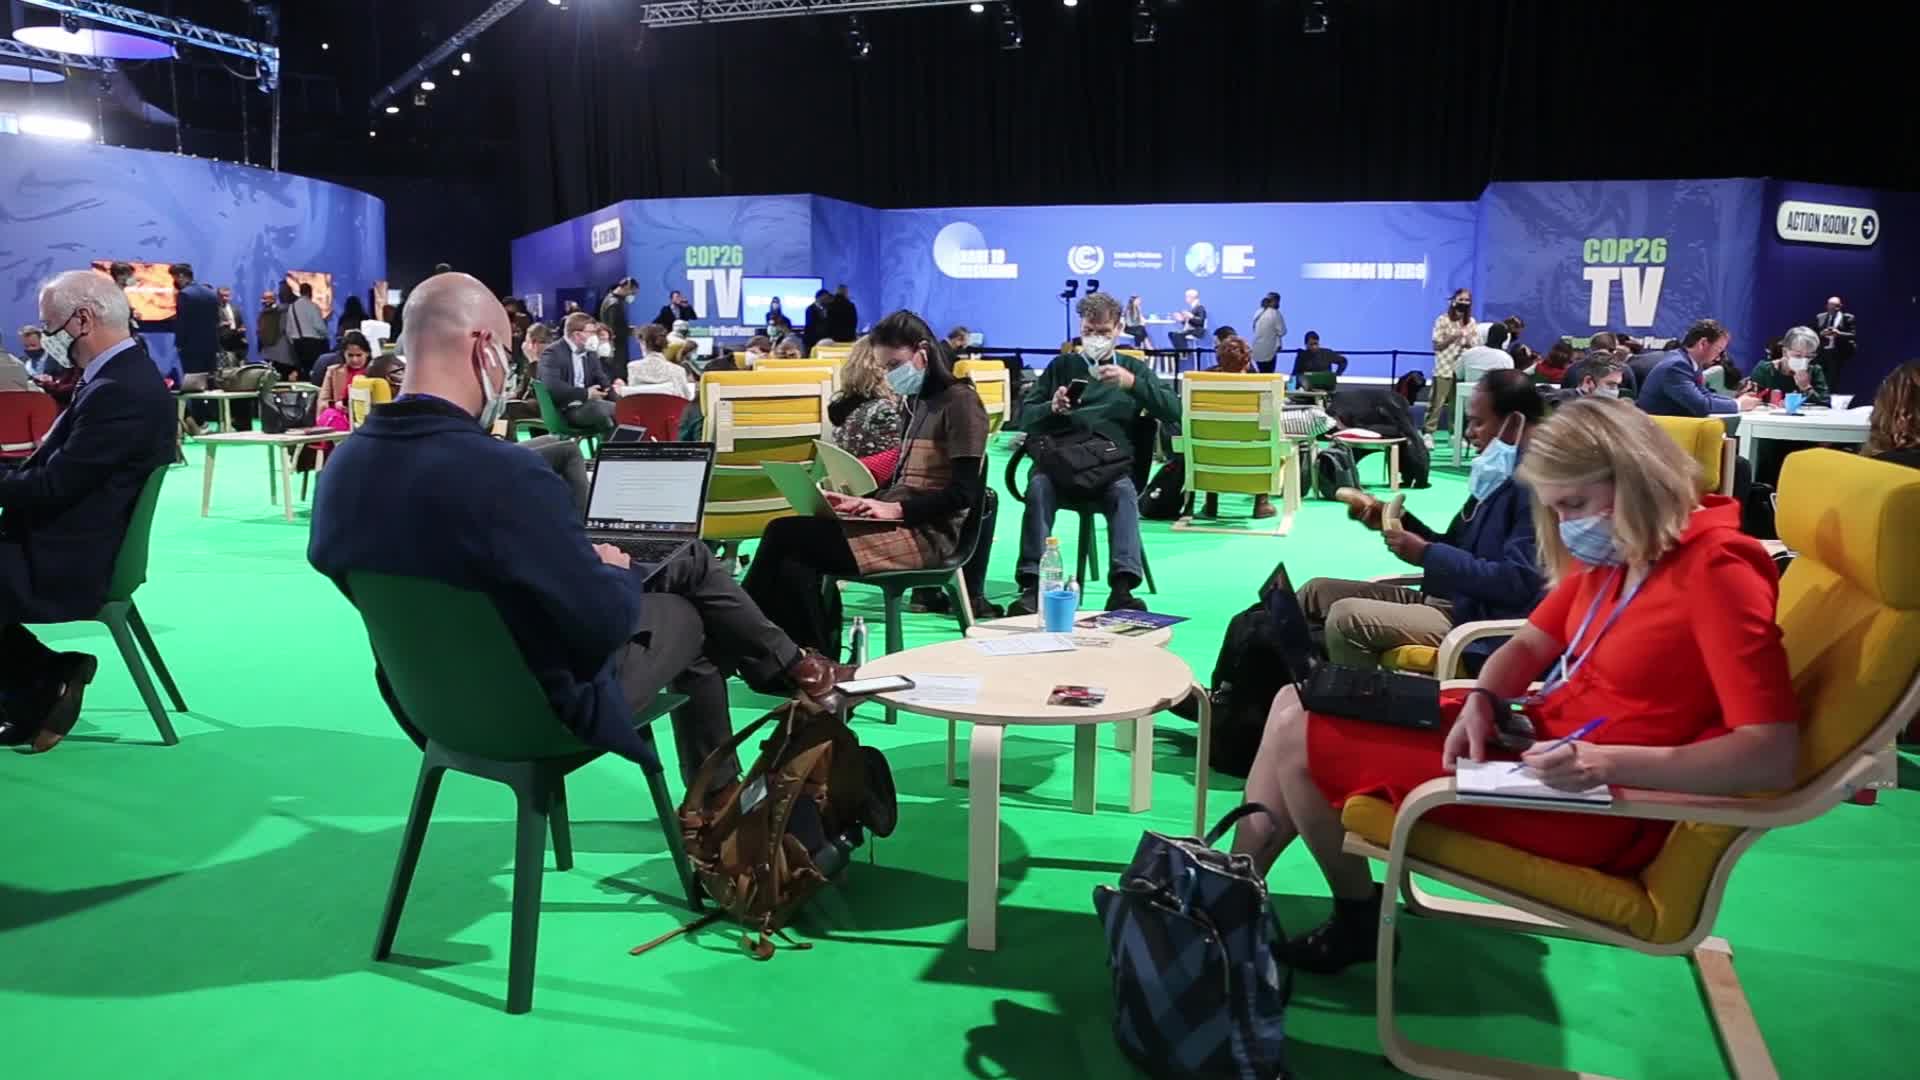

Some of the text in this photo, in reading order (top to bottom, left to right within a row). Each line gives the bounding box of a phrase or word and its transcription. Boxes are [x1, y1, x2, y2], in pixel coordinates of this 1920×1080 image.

[1787, 211, 1857, 235] ACTION ROOM 2
[686, 245, 743, 267] COP26
[1583, 238, 1667, 263] COP26
[686, 268, 743, 318] TV
[1583, 267, 1665, 327] TV
